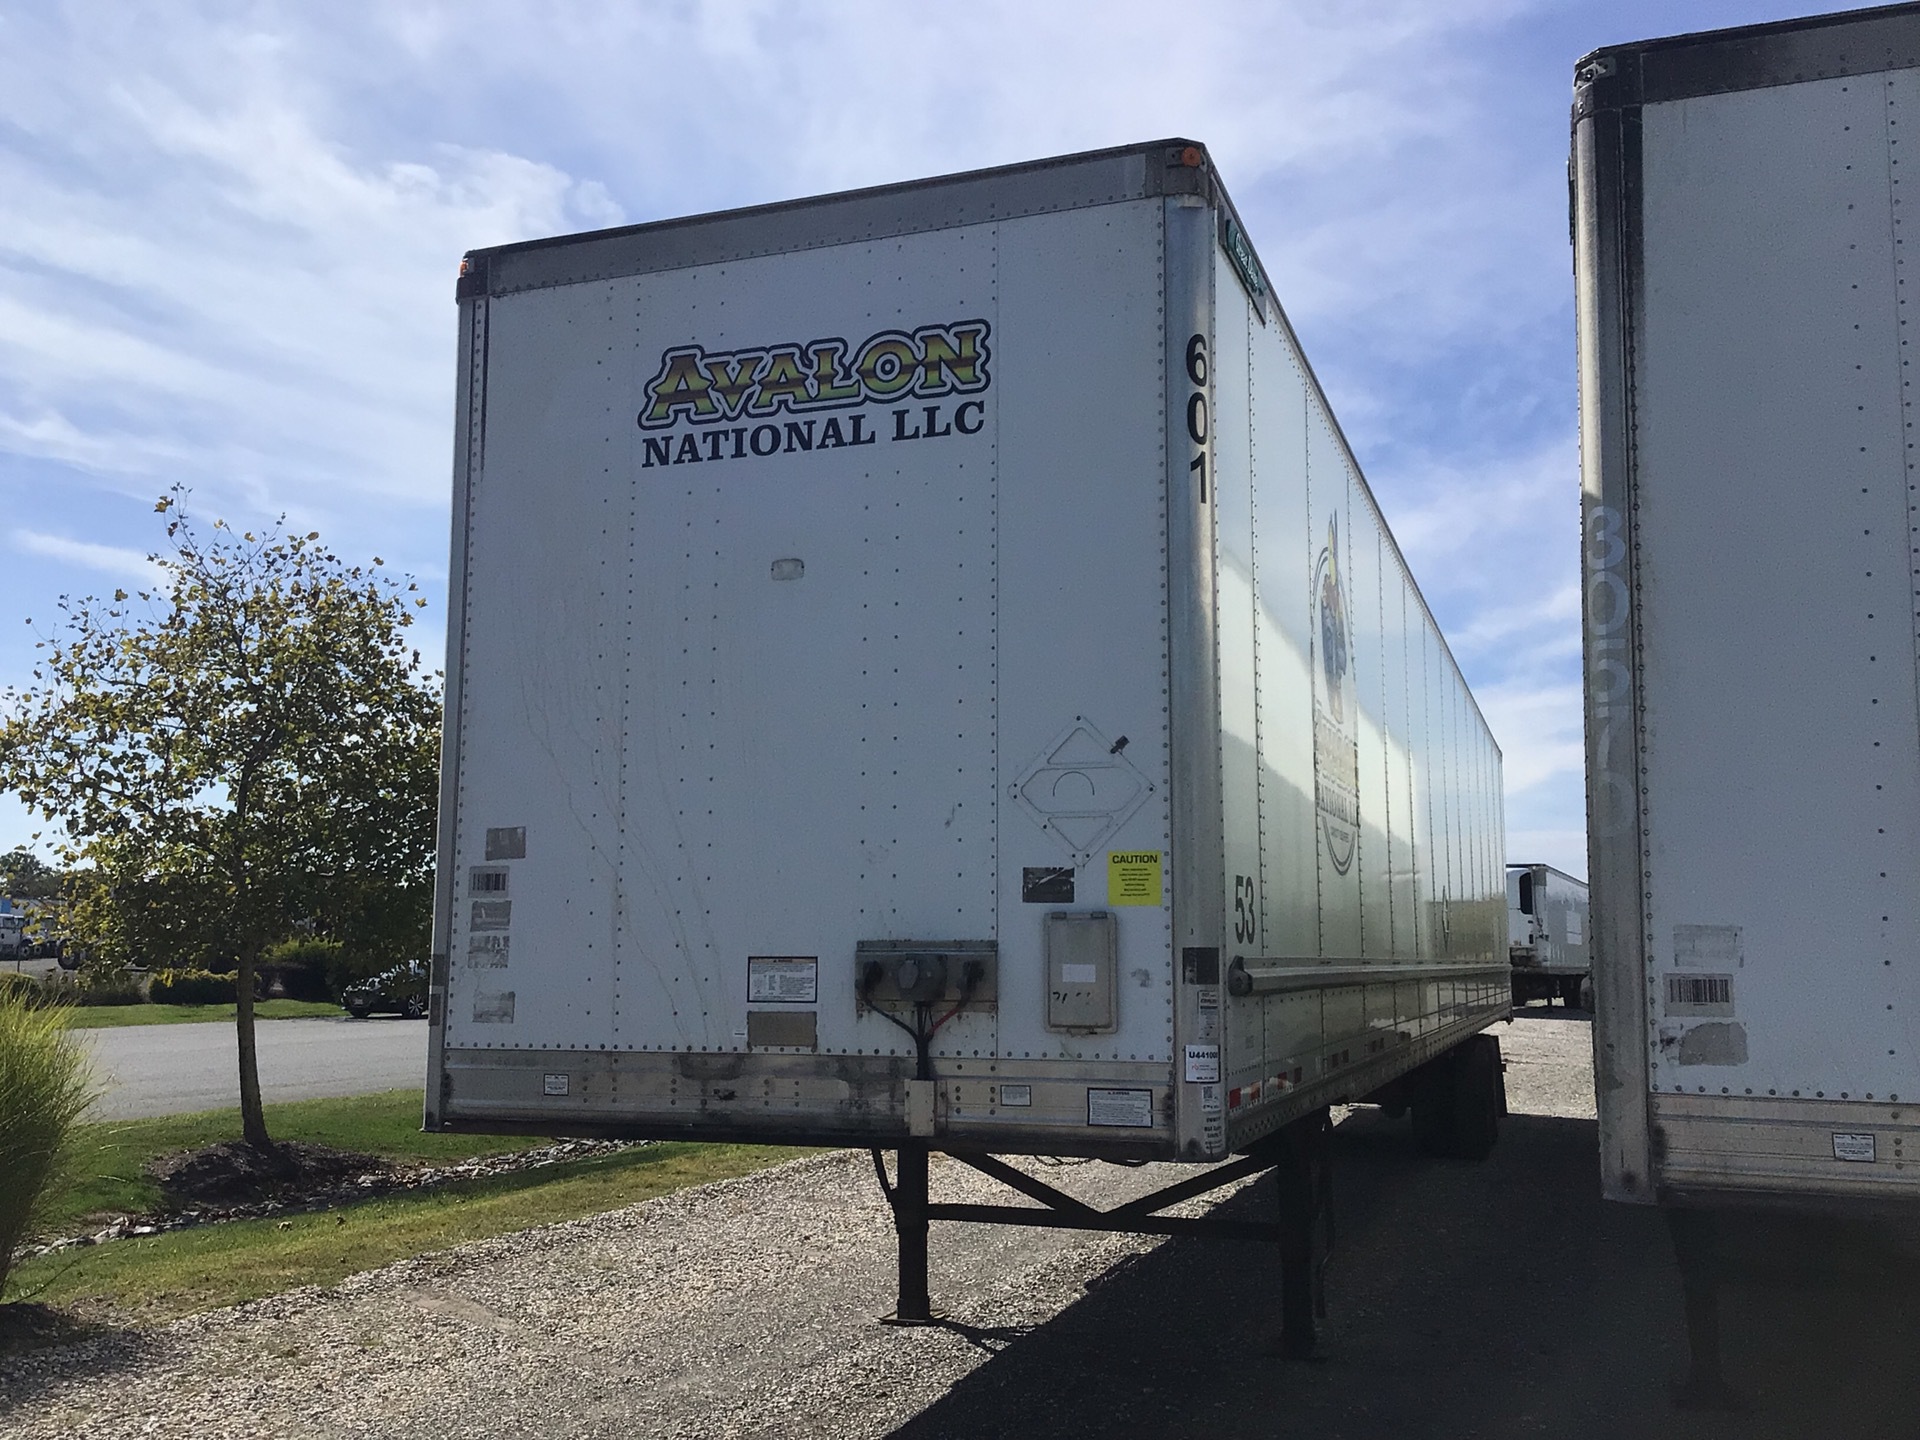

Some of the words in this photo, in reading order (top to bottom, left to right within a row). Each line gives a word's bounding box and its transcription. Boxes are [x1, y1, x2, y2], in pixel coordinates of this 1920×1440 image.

[642, 324, 988, 425] AVALON
[641, 414, 876, 468] NATIONAL
[891, 400, 985, 441] LLC
[1186, 333, 1207, 504] 601
[1112, 854, 1158, 864] CAUTION
[1235, 876, 1256, 944] 53
